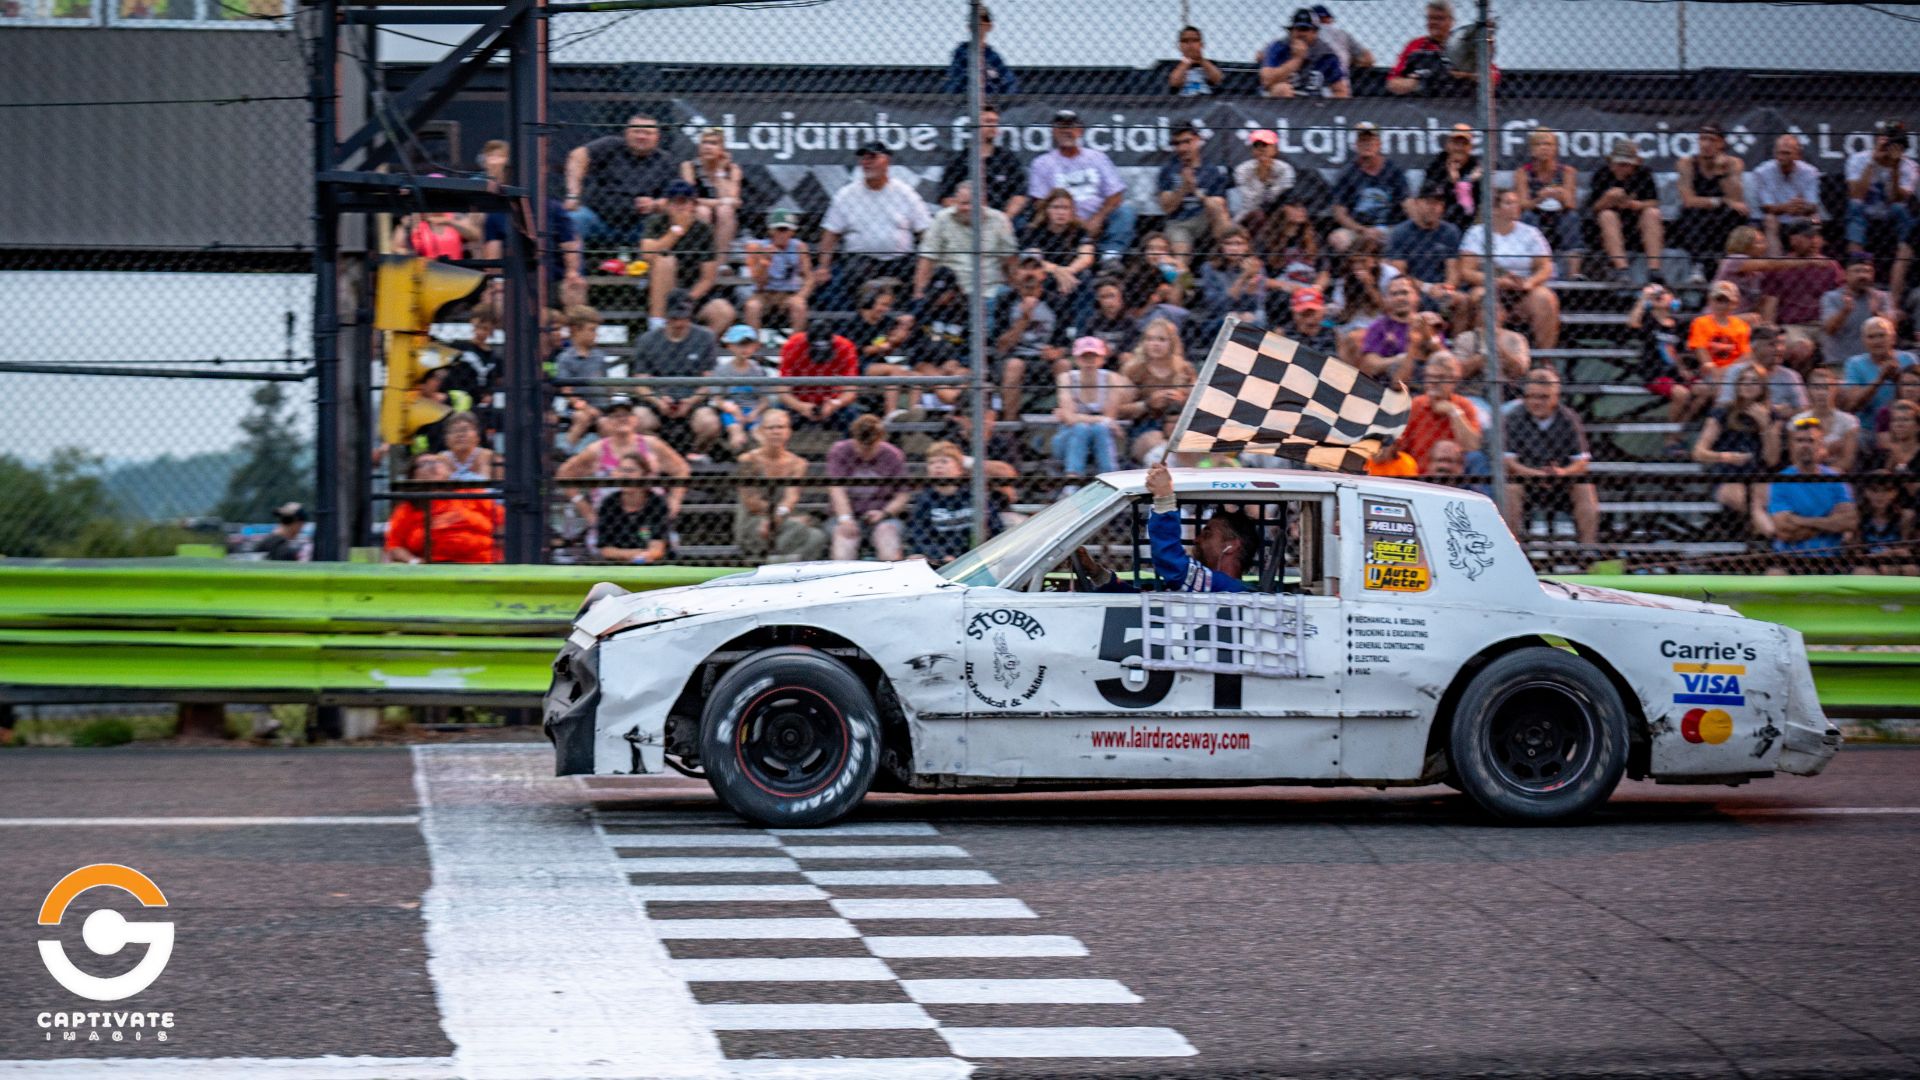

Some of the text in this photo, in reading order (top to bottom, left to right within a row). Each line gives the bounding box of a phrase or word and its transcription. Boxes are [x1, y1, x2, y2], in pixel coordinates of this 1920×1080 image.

[722, 111, 939, 160] Lajambe
[1372, 521, 1414, 533] MELLING
[1384, 567, 1418, 578] Auto
[1382, 577, 1425, 588] Meter
[966, 608, 1046, 641] STOBIE
[1355, 641, 1425, 651] GENERAL CONTRACTING
[1660, 640, 1757, 661] Carrie's
[1094, 606, 1242, 710] 51
[1354, 654, 1390, 663] ELECTRICAL
[1679, 673, 1741, 694] VISA
[1010, 698, 1022, 707] &
[1091, 726, 1250, 755] www.lairdraceway.com
